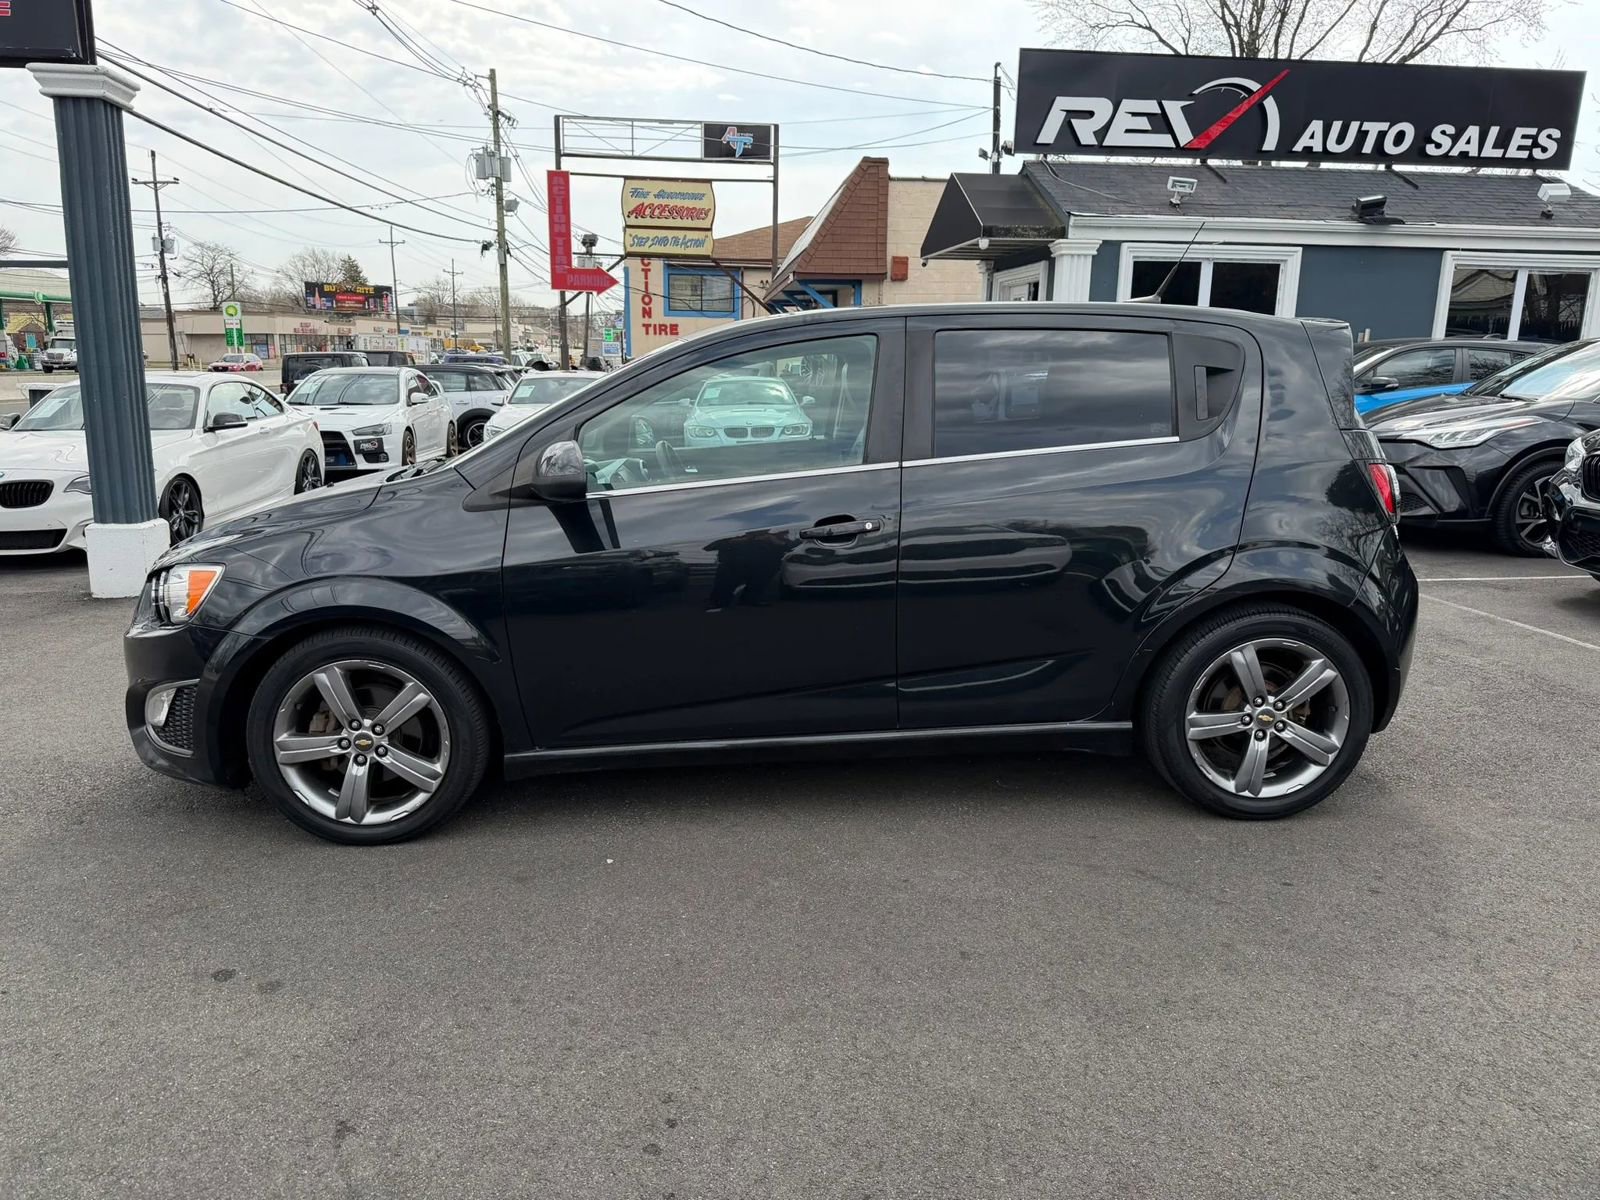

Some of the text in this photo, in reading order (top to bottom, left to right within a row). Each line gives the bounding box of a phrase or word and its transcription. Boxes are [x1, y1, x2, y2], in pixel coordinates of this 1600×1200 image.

[1036, 88, 1562, 160] REV AUTO SALES
[627, 202, 711, 220] ACCESSORIES
[641, 258, 680, 336] CTION TIRE
